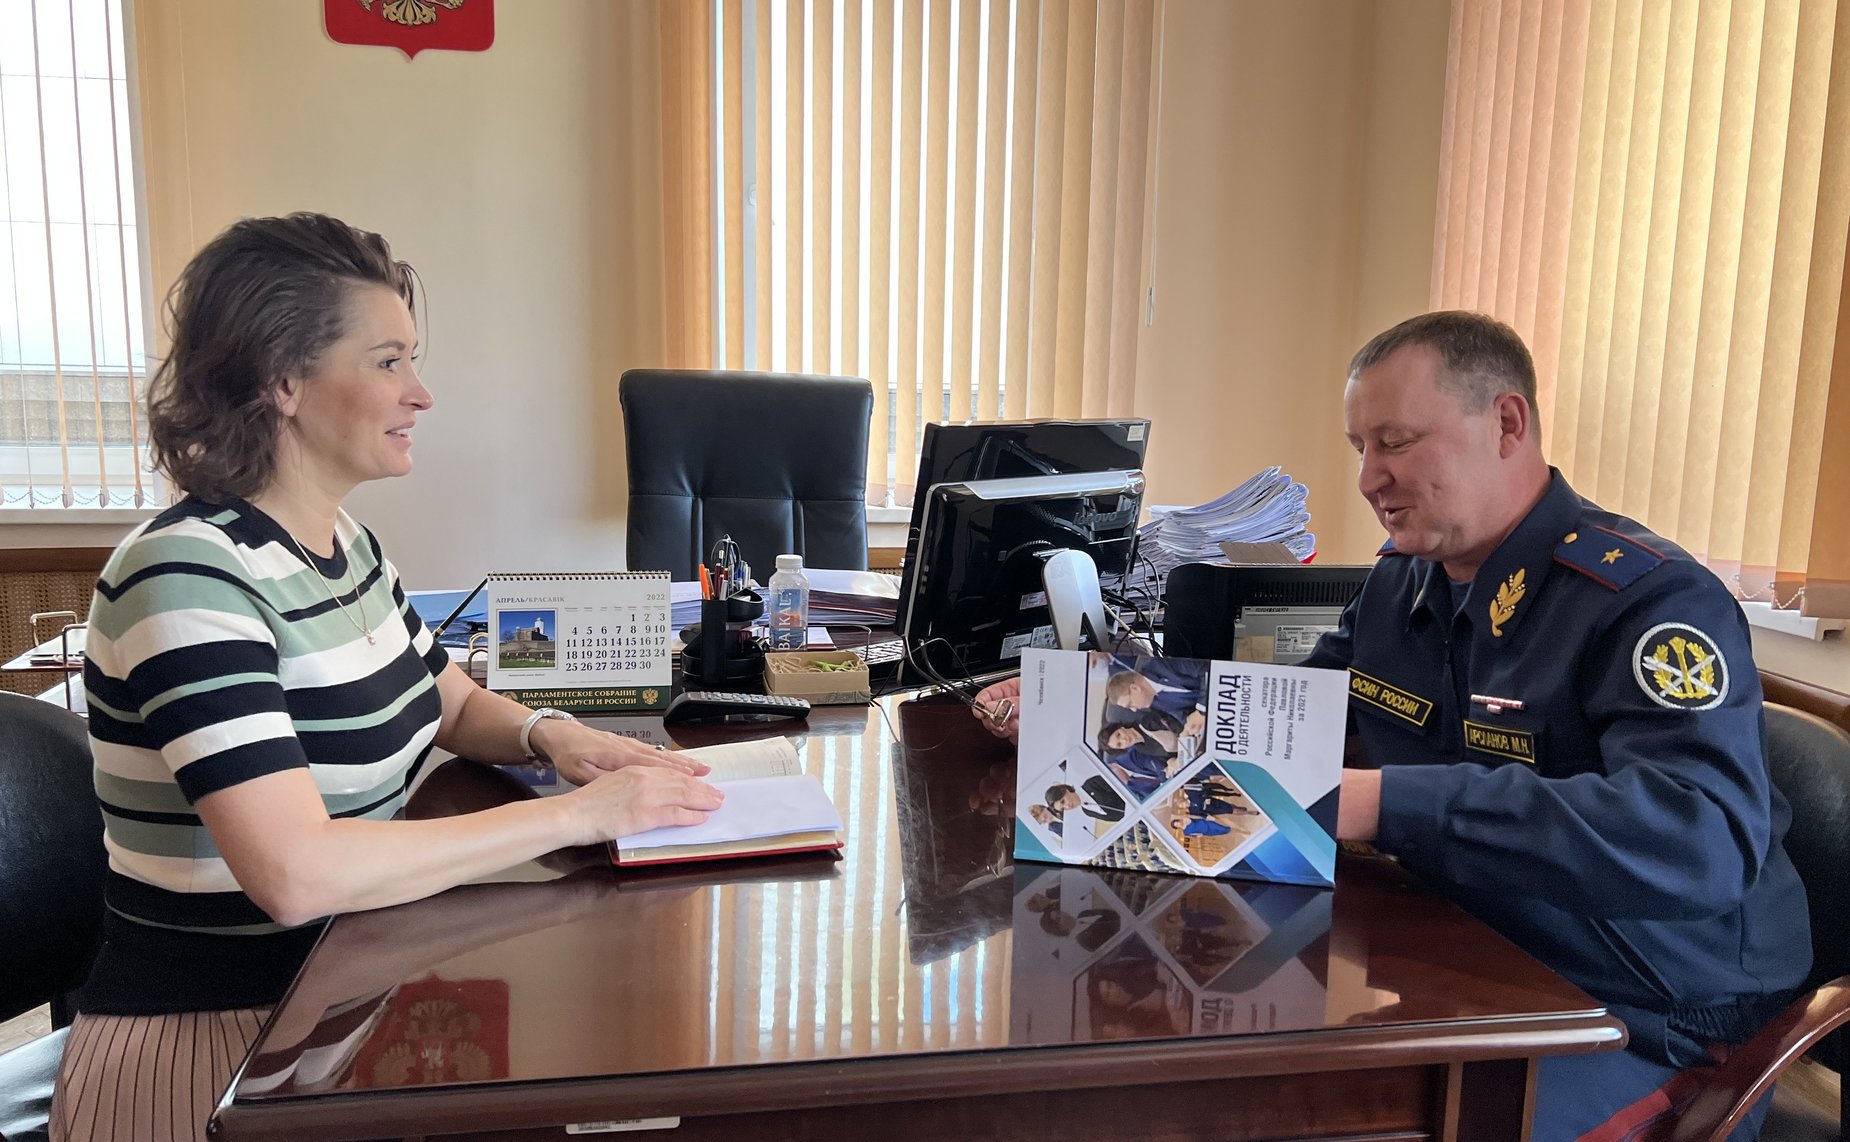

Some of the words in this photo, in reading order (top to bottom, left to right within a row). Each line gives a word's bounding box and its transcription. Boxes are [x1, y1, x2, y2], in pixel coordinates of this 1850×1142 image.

[1073, 511, 1118, 525] lenovo
[631, 613, 635, 622] 1
[644, 613, 650, 622] 2
[660, 612, 665, 621] 3
[572, 626, 578, 635] 4
[586, 626, 593, 635] 5
[601, 626, 607, 634] 6
[616, 625, 622, 634] 7
[630, 625, 637, 634] 8
[645, 625, 651, 633] 9
[655, 625, 665, 633] 10
[566, 639, 577, 647] 11
[581, 638, 593, 647] 12
[596, 638, 607, 647] 13
[611, 638, 622, 646] 14
[626, 637, 637, 646] 15
[640, 637, 651, 646] 16
[655, 637, 665, 645] 17
[566, 651, 578, 660] 18
[581, 650, 593, 659] 19
[595, 650, 607, 659] 20
[610, 649, 621, 658] 21
[625, 649, 637, 658] 22
[640, 649, 651, 657] 23
[654, 648, 665, 657] 24
[565, 662, 578, 671] 25
[581, 662, 593, 671] 26
[595, 662, 607, 671] 27
[610, 661, 622, 670] 28
[625, 661, 637, 670] 29
[640, 661, 651, 669] 30
[1261, 676, 1269, 708] сенатора
[1300, 680, 1308, 693] год
[522, 691, 593, 699] ПАРЛАМЕНТСКОЕ
[1268, 677, 1277, 716] Федерации
[1279, 678, 1288, 711] Павловой
[1287, 679, 1297, 721] Николаевны
[1352, 677, 1380, 698] ФСИН
[1380, 689, 1420, 716] РОССИИ
[522, 699, 552, 707] СОЮЗА
[1298, 694, 1306, 711] 2021
[1215, 674, 1241, 754] ДОКЛАД
[1238, 675, 1252, 747] ДЕЯТЕЛЬНОСТИ
[1298, 713, 1305, 722] за
[1264, 717, 1275, 757] Российской
[1283, 722, 1294, 760] Маргариты
